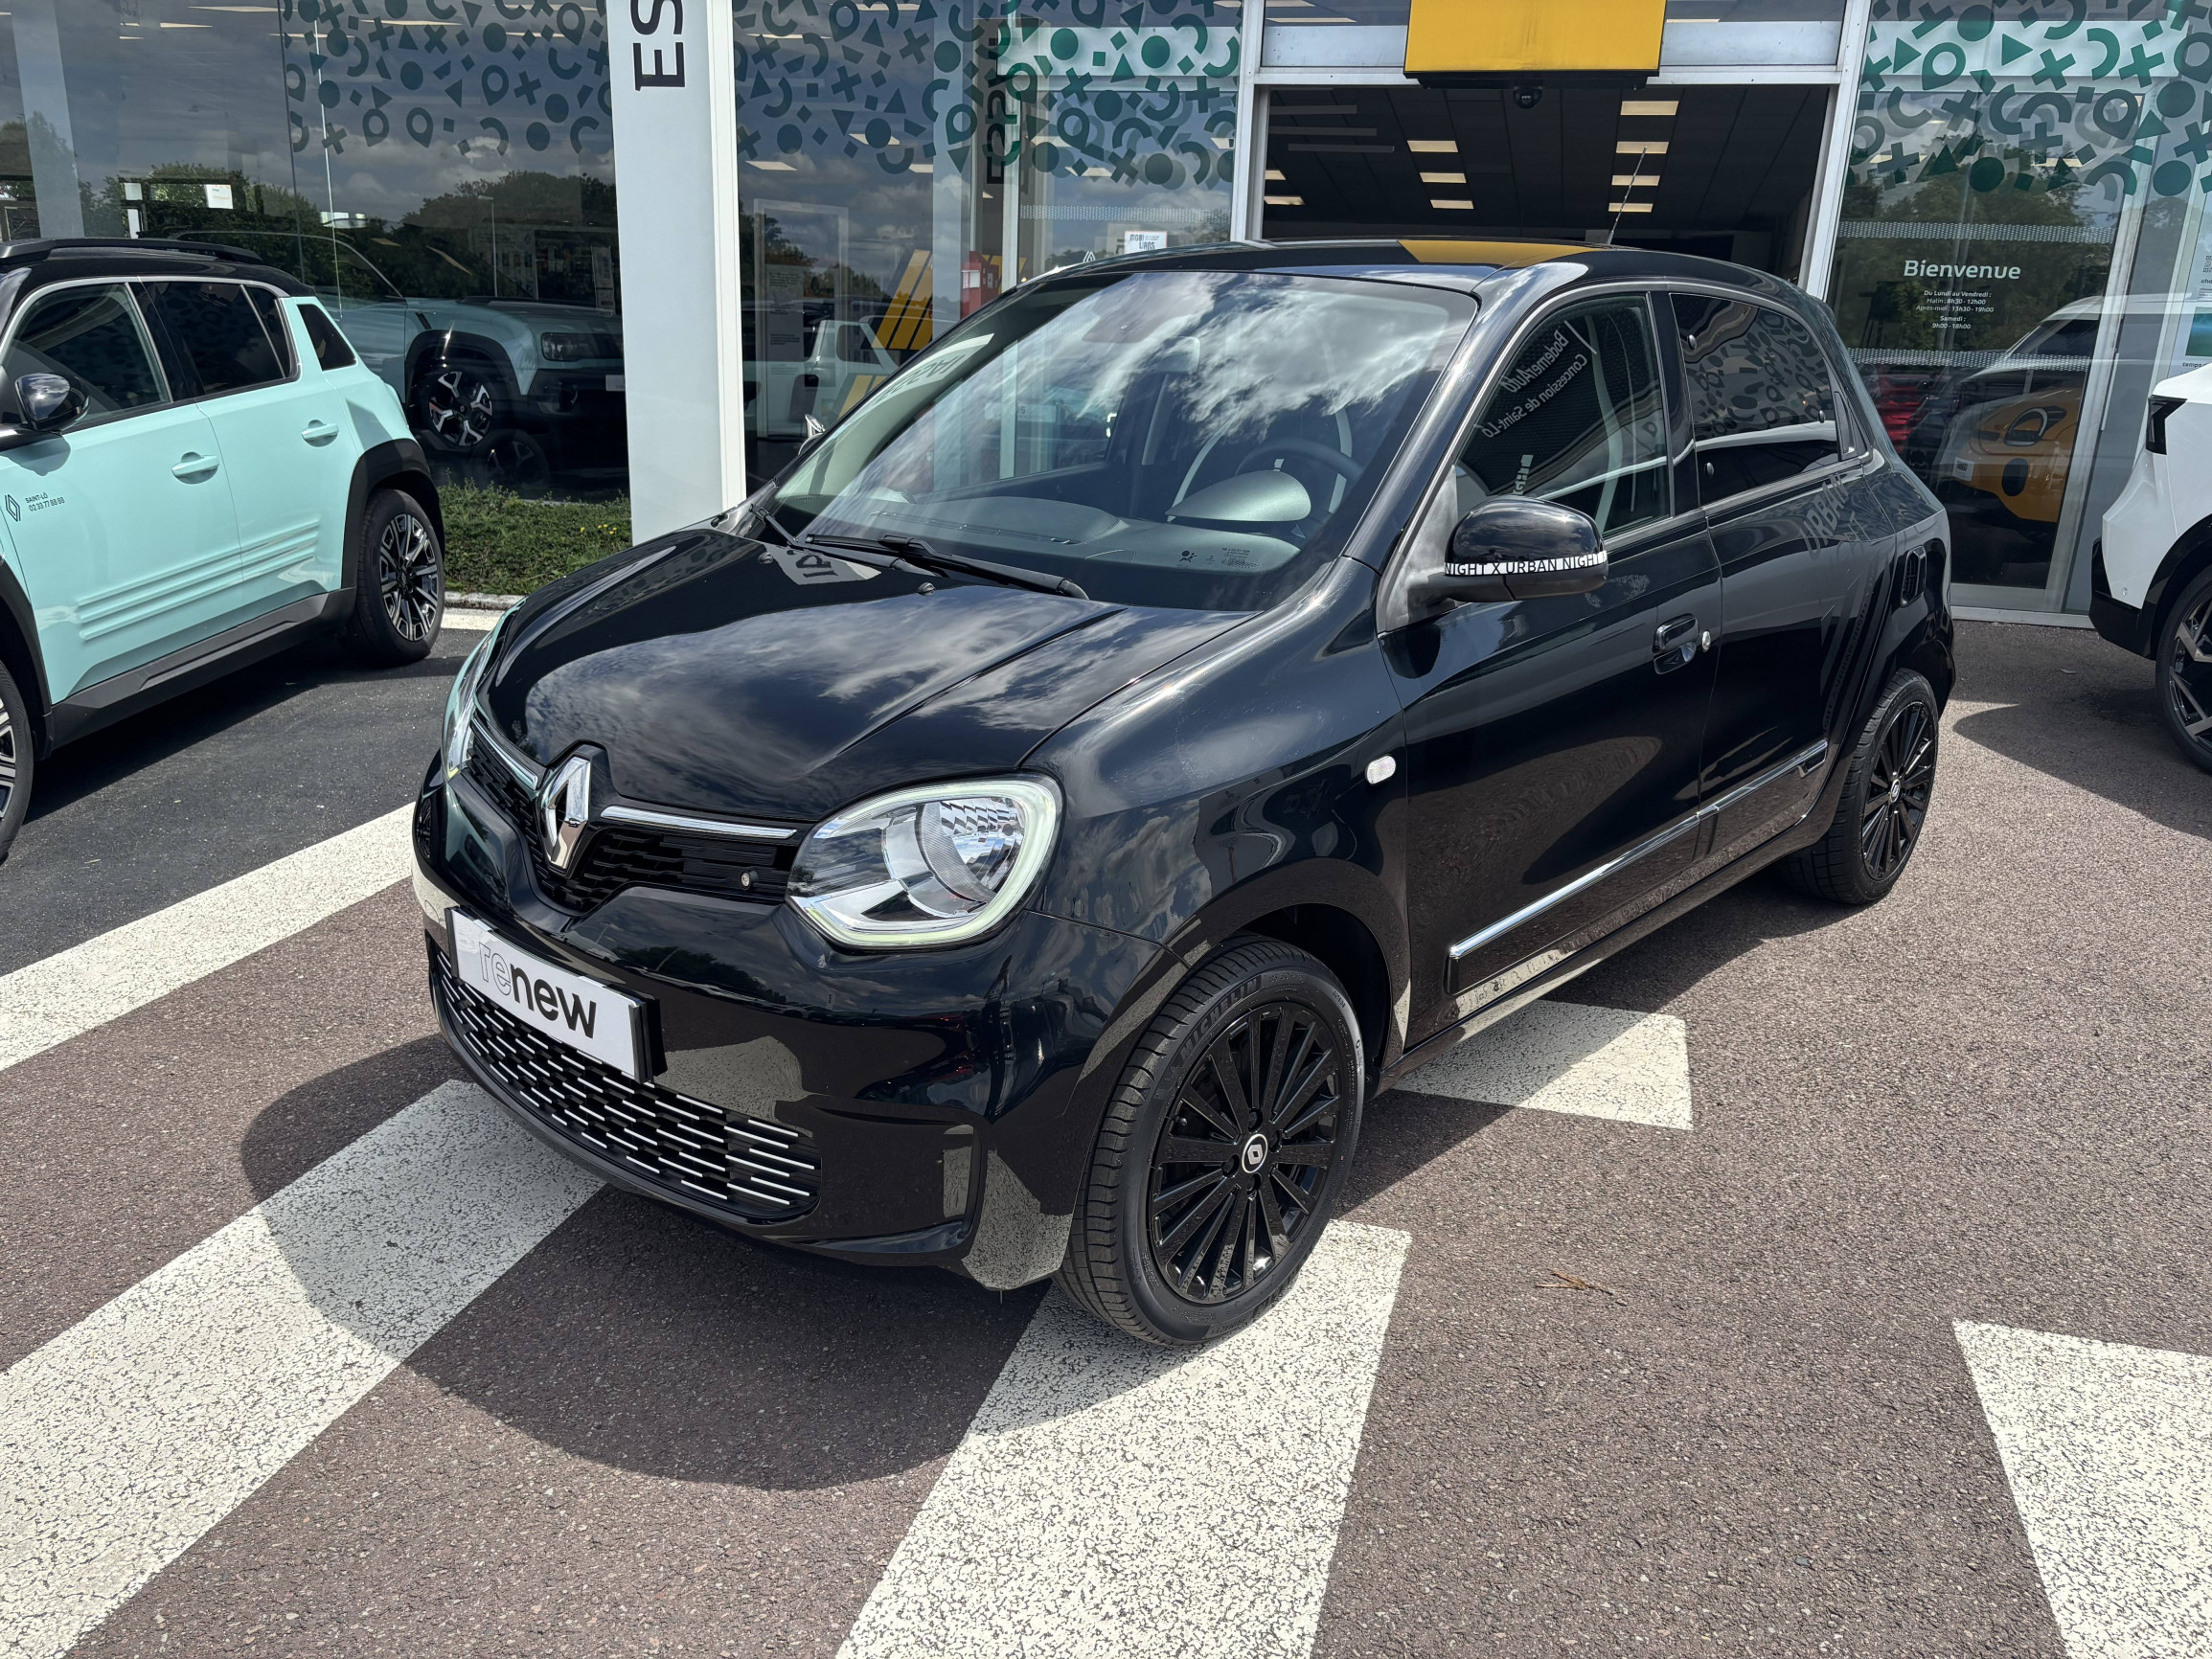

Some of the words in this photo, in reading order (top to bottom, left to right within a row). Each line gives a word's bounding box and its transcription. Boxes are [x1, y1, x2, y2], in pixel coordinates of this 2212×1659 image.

[1904, 260, 2021, 280] Bienvenue
[1445, 561, 1487, 576] NIGHT
[1492, 562, 1501, 575] X
[1506, 558, 1557, 574] URBAN
[479, 942, 597, 1039] renew
[1180, 977, 1258, 1061] MICHELIN
